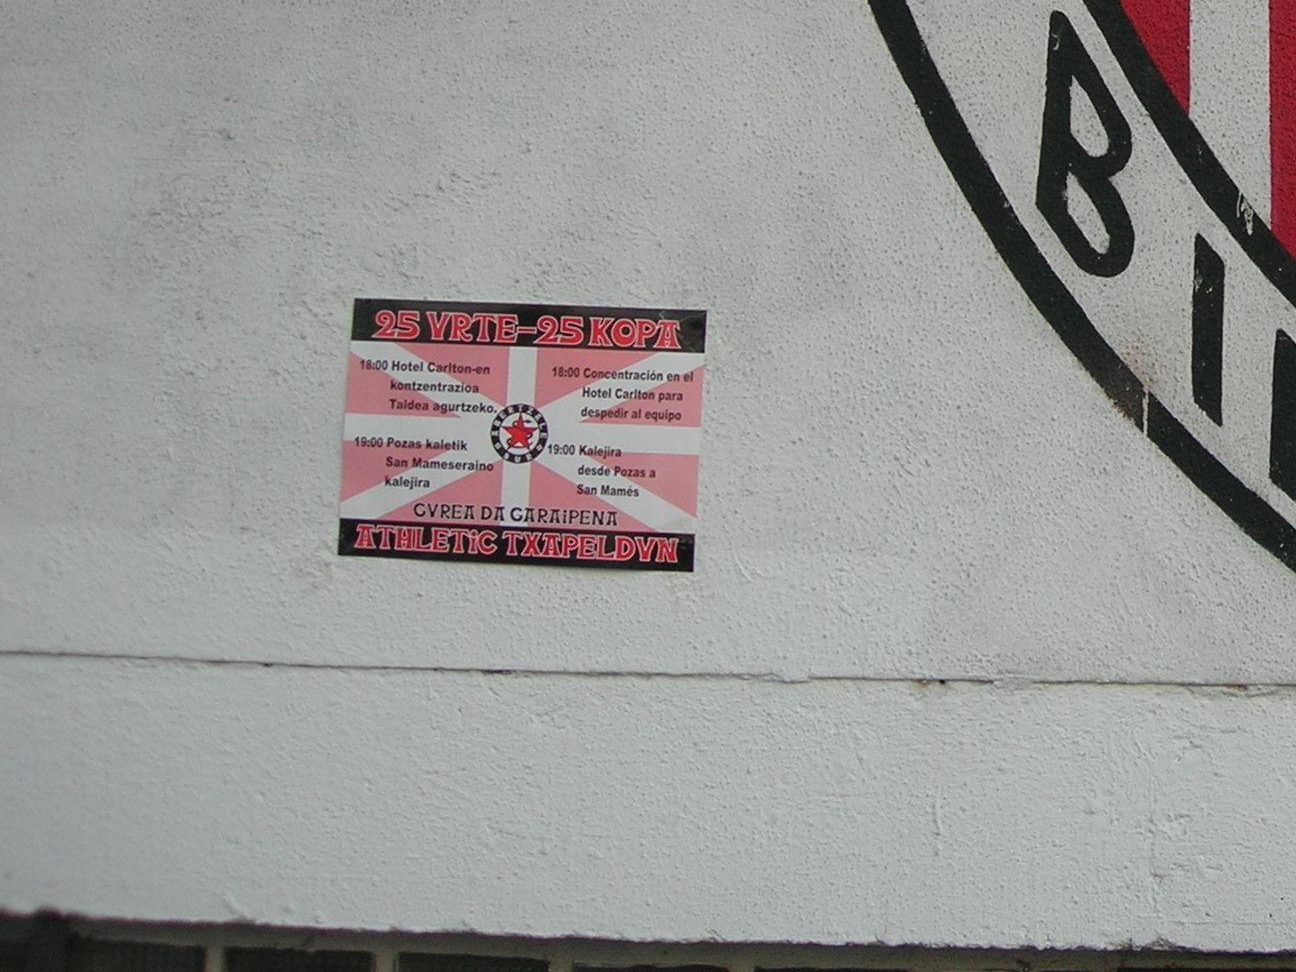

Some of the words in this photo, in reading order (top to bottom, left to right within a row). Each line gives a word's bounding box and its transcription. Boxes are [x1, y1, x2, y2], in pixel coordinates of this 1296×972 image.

[371, 310, 421, 340] 25
[588, 317, 682, 349] KOPA
[360, 359, 388, 371] 18:00
[391, 360, 423, 372] Hotel
[427, 362, 490, 375] Carlton-en
[552, 366, 580, 378] 18:00
[583, 367, 663, 382] Concentración
[666, 373, 681, 381] en
[683, 371, 693, 382] el
[390, 380, 479, 393] kontzentrazioa
[582, 387, 611, 399] Hotel
[615, 388, 655, 401] Carlton
[658, 392, 683, 402] para
[389, 398, 429, 411] Taldea
[581, 406, 628, 420] despedir
[631, 409, 641, 419] al
[645, 410, 682, 423] equipo
[354, 436, 383, 448] 19:00
[386, 437, 422, 449] Pozas
[426, 438, 468, 451] kaletik
[548, 444, 576, 456] 19:00
[579, 445, 622, 459] Kalejira
[386, 456, 408, 468] San
[412, 458, 494, 472] Mameseraino
[578, 465, 611, 477] desde
[614, 467, 646, 478] Pozas
[649, 470, 656, 478] a
[385, 476, 430, 490] kalejira
[577, 484, 597, 496] San
[600, 485, 640, 497] Mamés
[481, 506, 505, 521] DA
